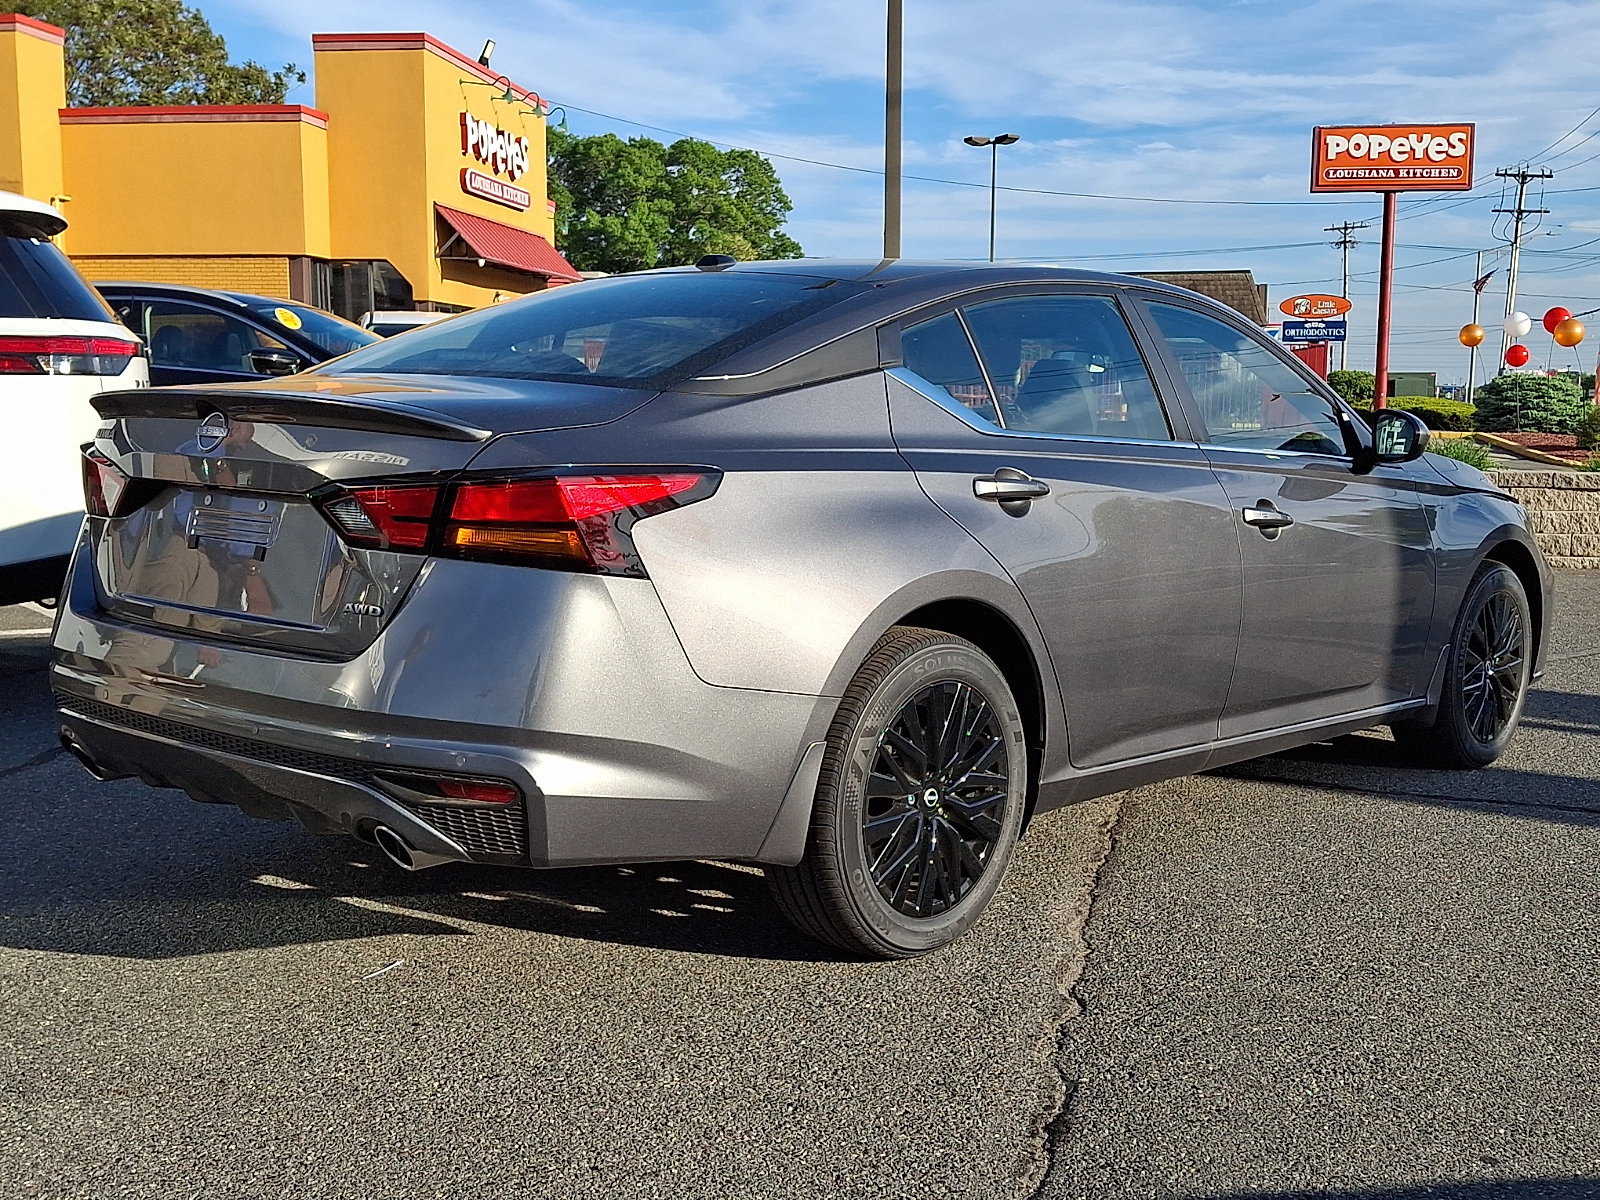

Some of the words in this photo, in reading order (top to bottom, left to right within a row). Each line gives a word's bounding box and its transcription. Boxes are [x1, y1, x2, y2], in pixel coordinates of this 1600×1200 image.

[1328, 168, 1396, 178] LOUISIANA
[1398, 168, 1459, 177] KITCHEN
[471, 174, 502, 197] LOUISIANA
[1285, 328, 1345, 337] ORTHODONTICS
[197, 425, 229, 438] SSAN
[343, 602, 383, 617] AWD
